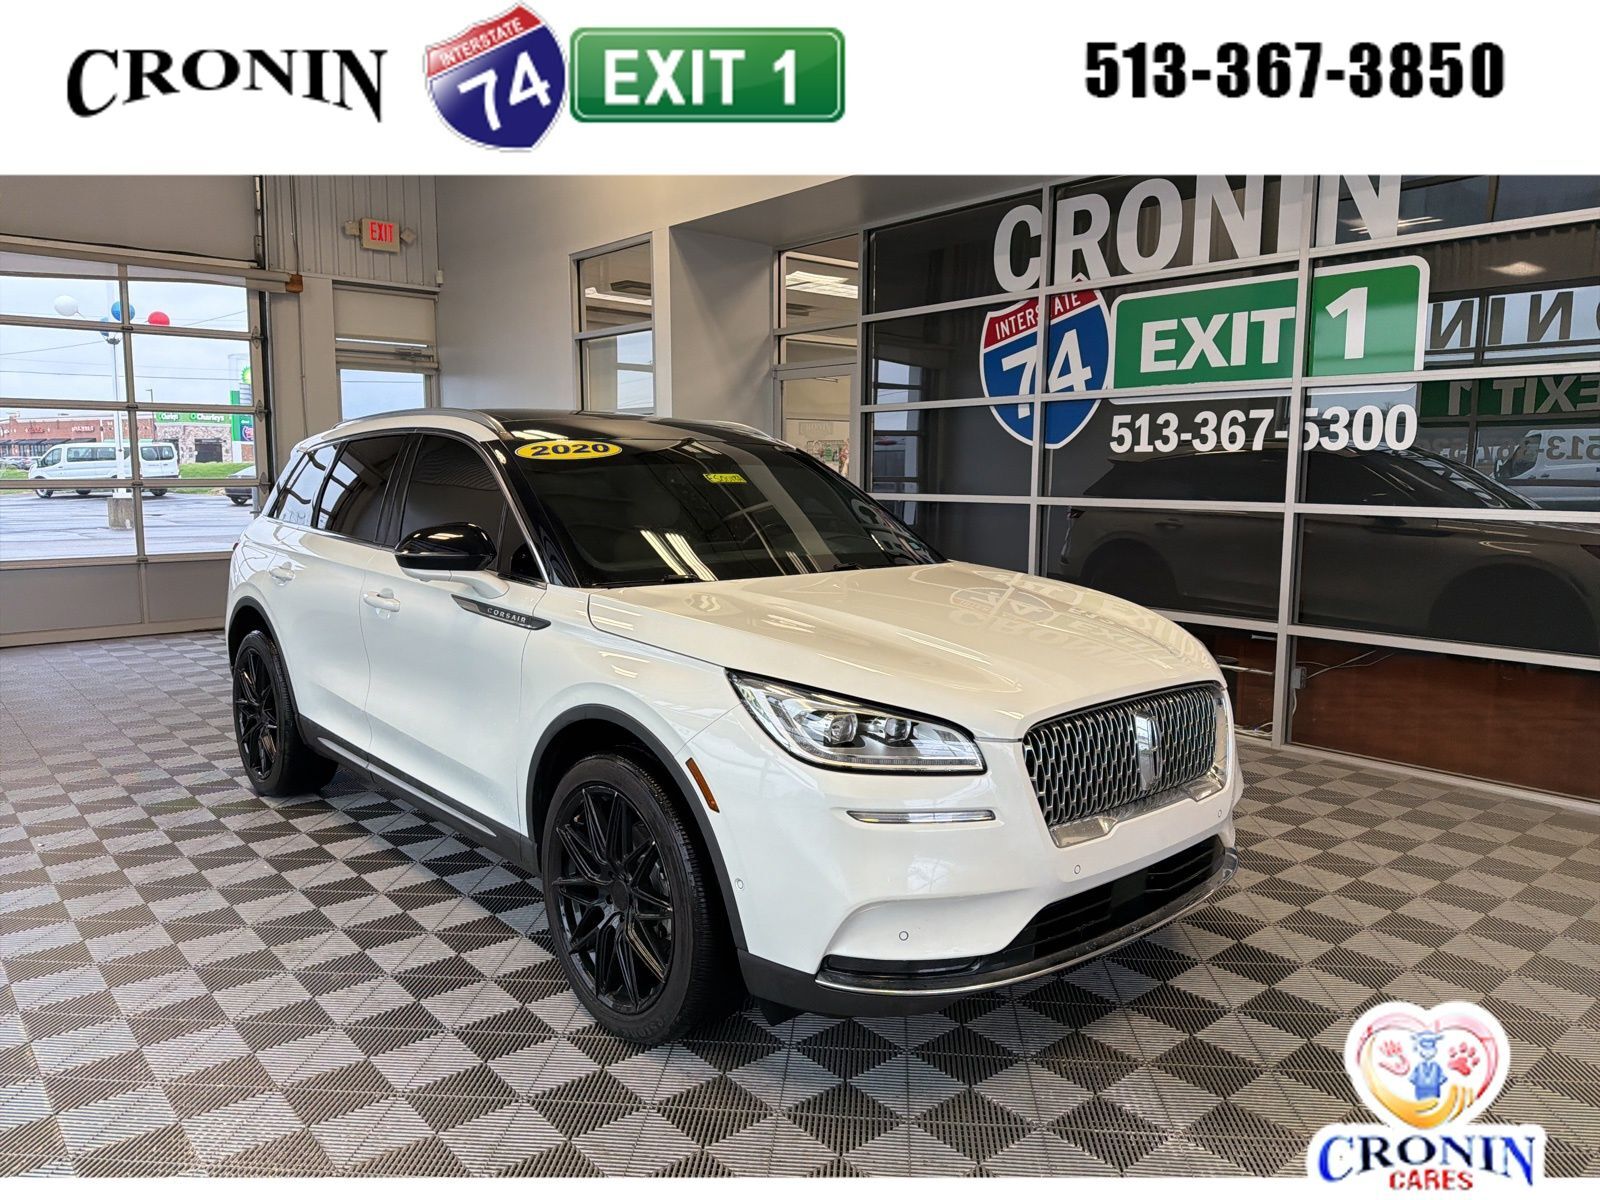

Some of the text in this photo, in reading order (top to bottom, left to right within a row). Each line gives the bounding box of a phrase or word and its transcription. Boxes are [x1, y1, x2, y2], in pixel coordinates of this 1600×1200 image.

[369, 221, 394, 243] EXIT
[994, 175, 1402, 292] CRONIN
[995, 292, 1081, 340] INTERSATE
[1140, 287, 1368, 373] EXIT 1
[1001, 329, 1092, 419] 74
[531, 443, 609, 456] 2020
[1109, 404, 1418, 453] 513-367-5300
[487, 607, 527, 623] CORSAIR
